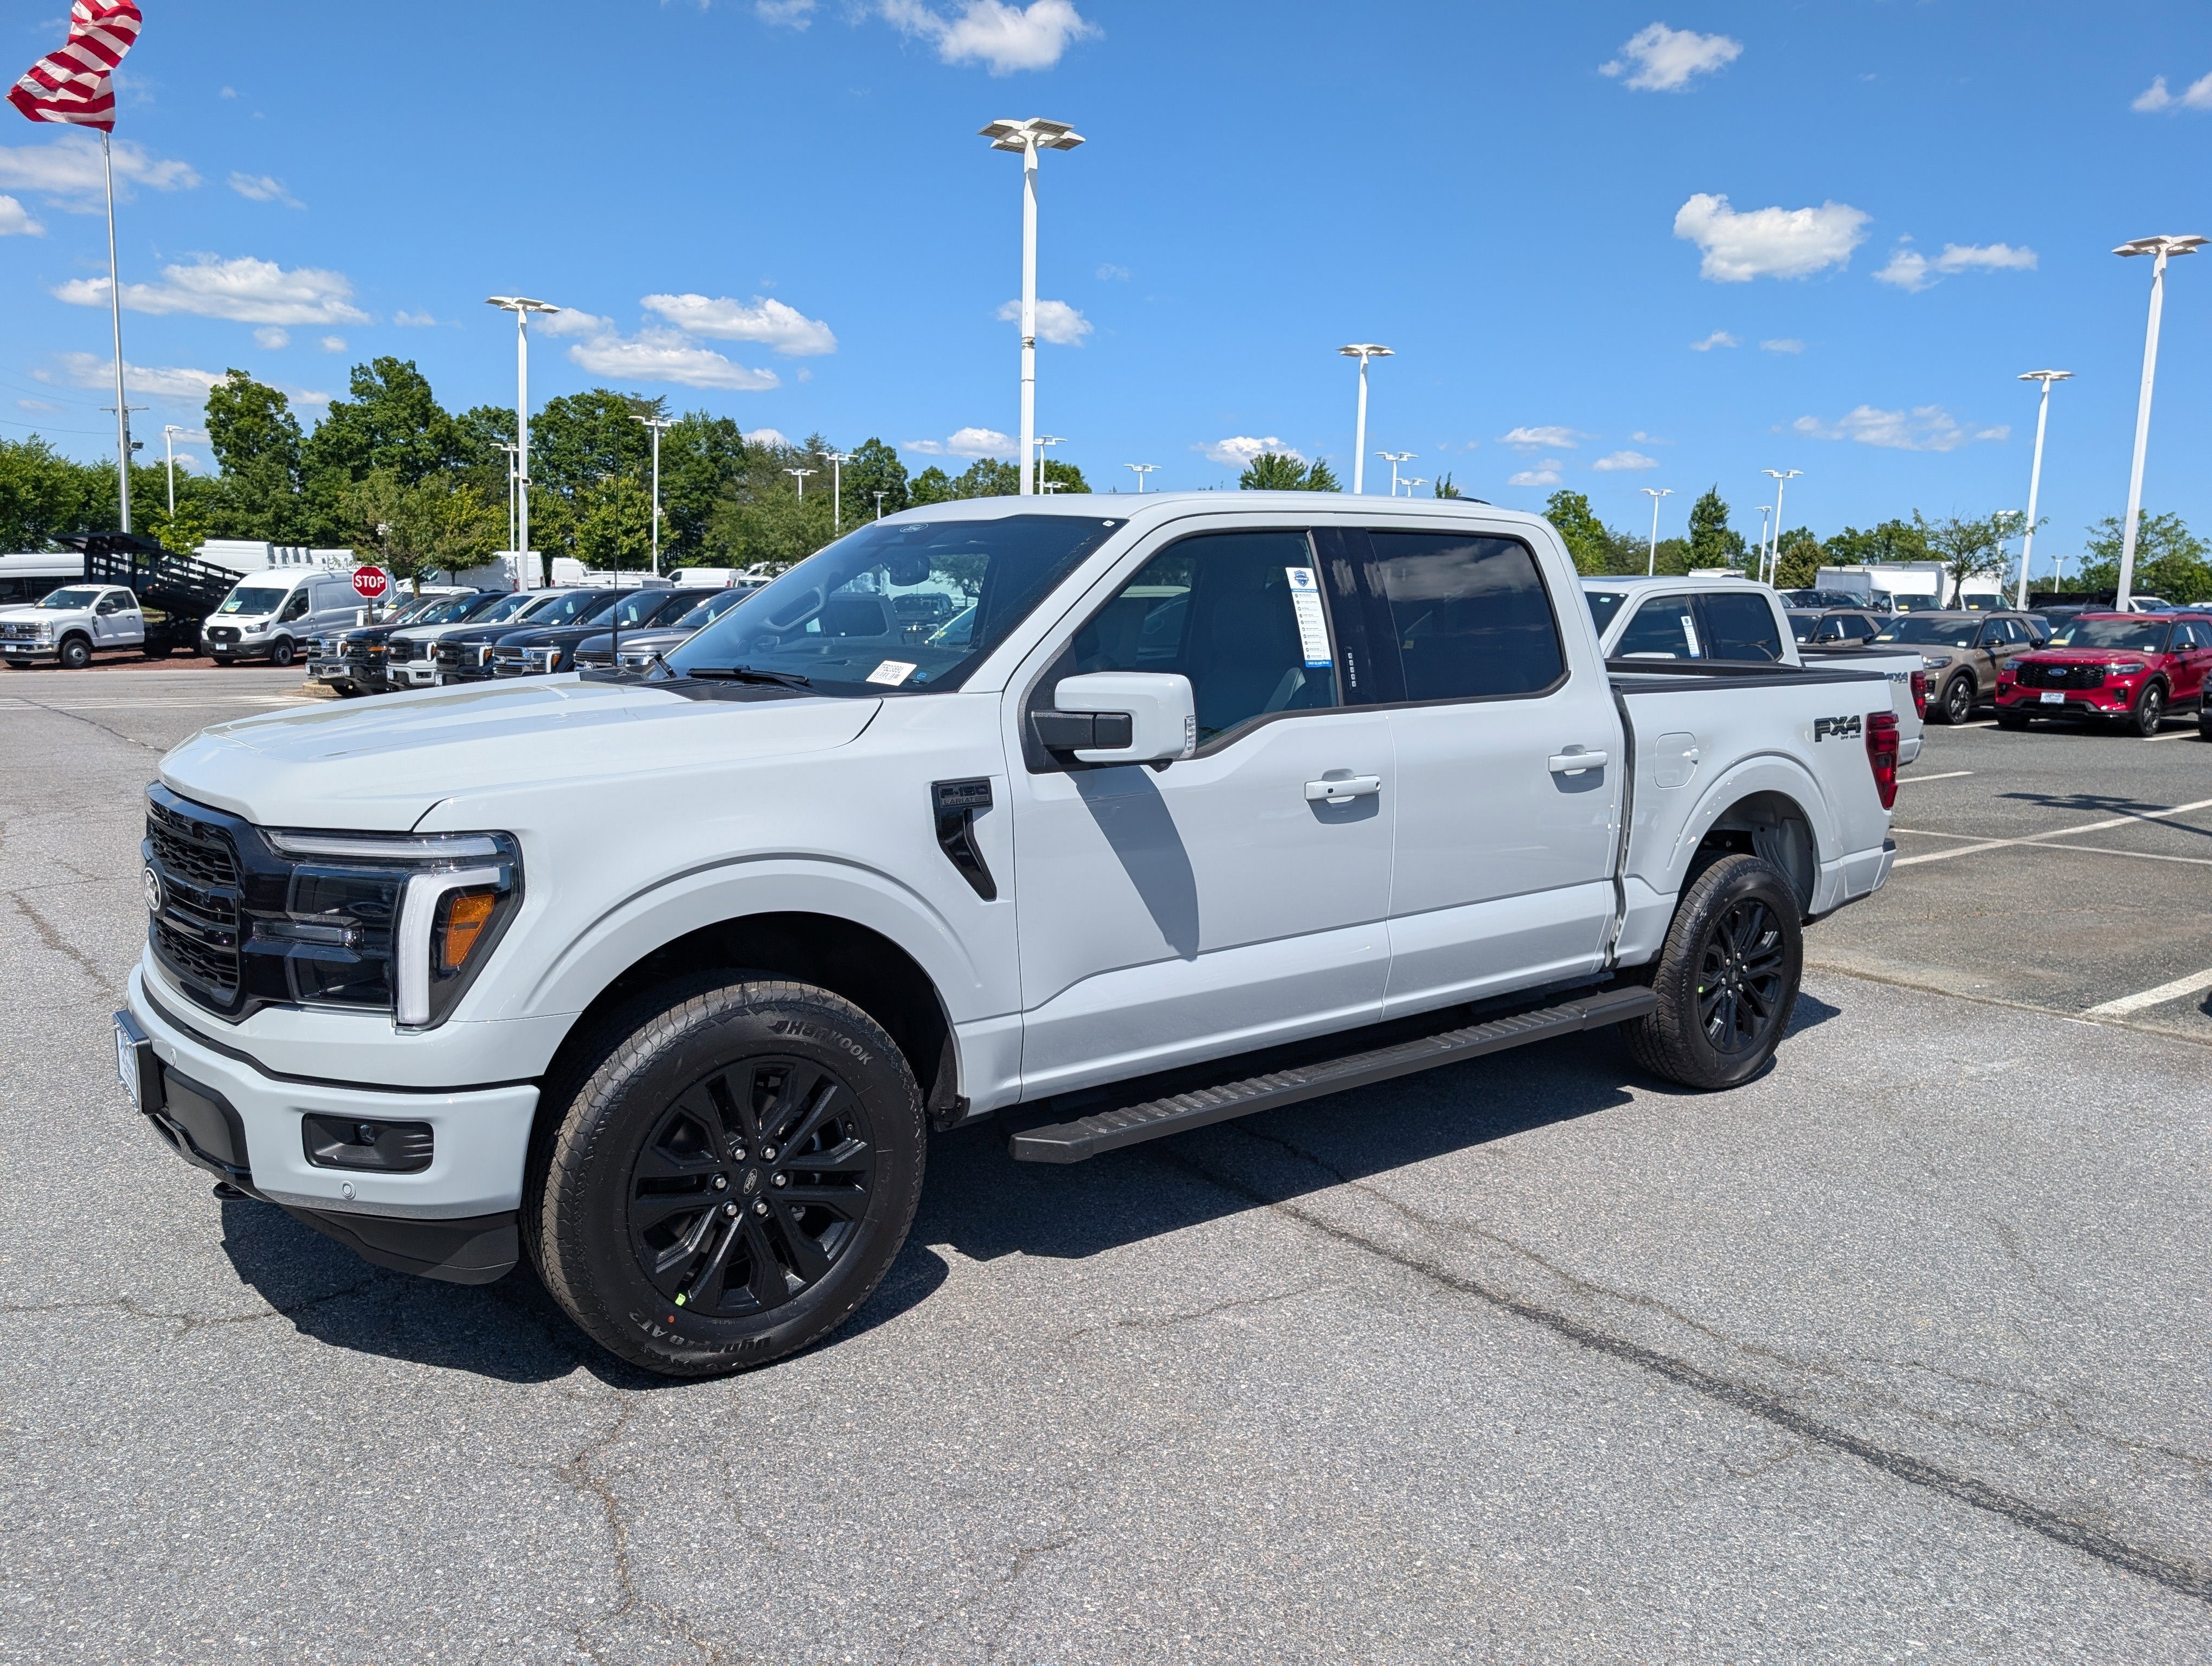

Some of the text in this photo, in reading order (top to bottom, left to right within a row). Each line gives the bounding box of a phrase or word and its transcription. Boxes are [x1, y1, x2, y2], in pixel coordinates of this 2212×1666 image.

[355, 575, 385, 588] STOP
[1814, 715, 1861, 743] FX4
[940, 785, 988, 799] F-150
[942, 797, 975, 806] LARIAT
[144, 870, 158, 907] Ford
[786, 1021, 873, 1065] Hankook
[744, 1171, 756, 1191] Ford
